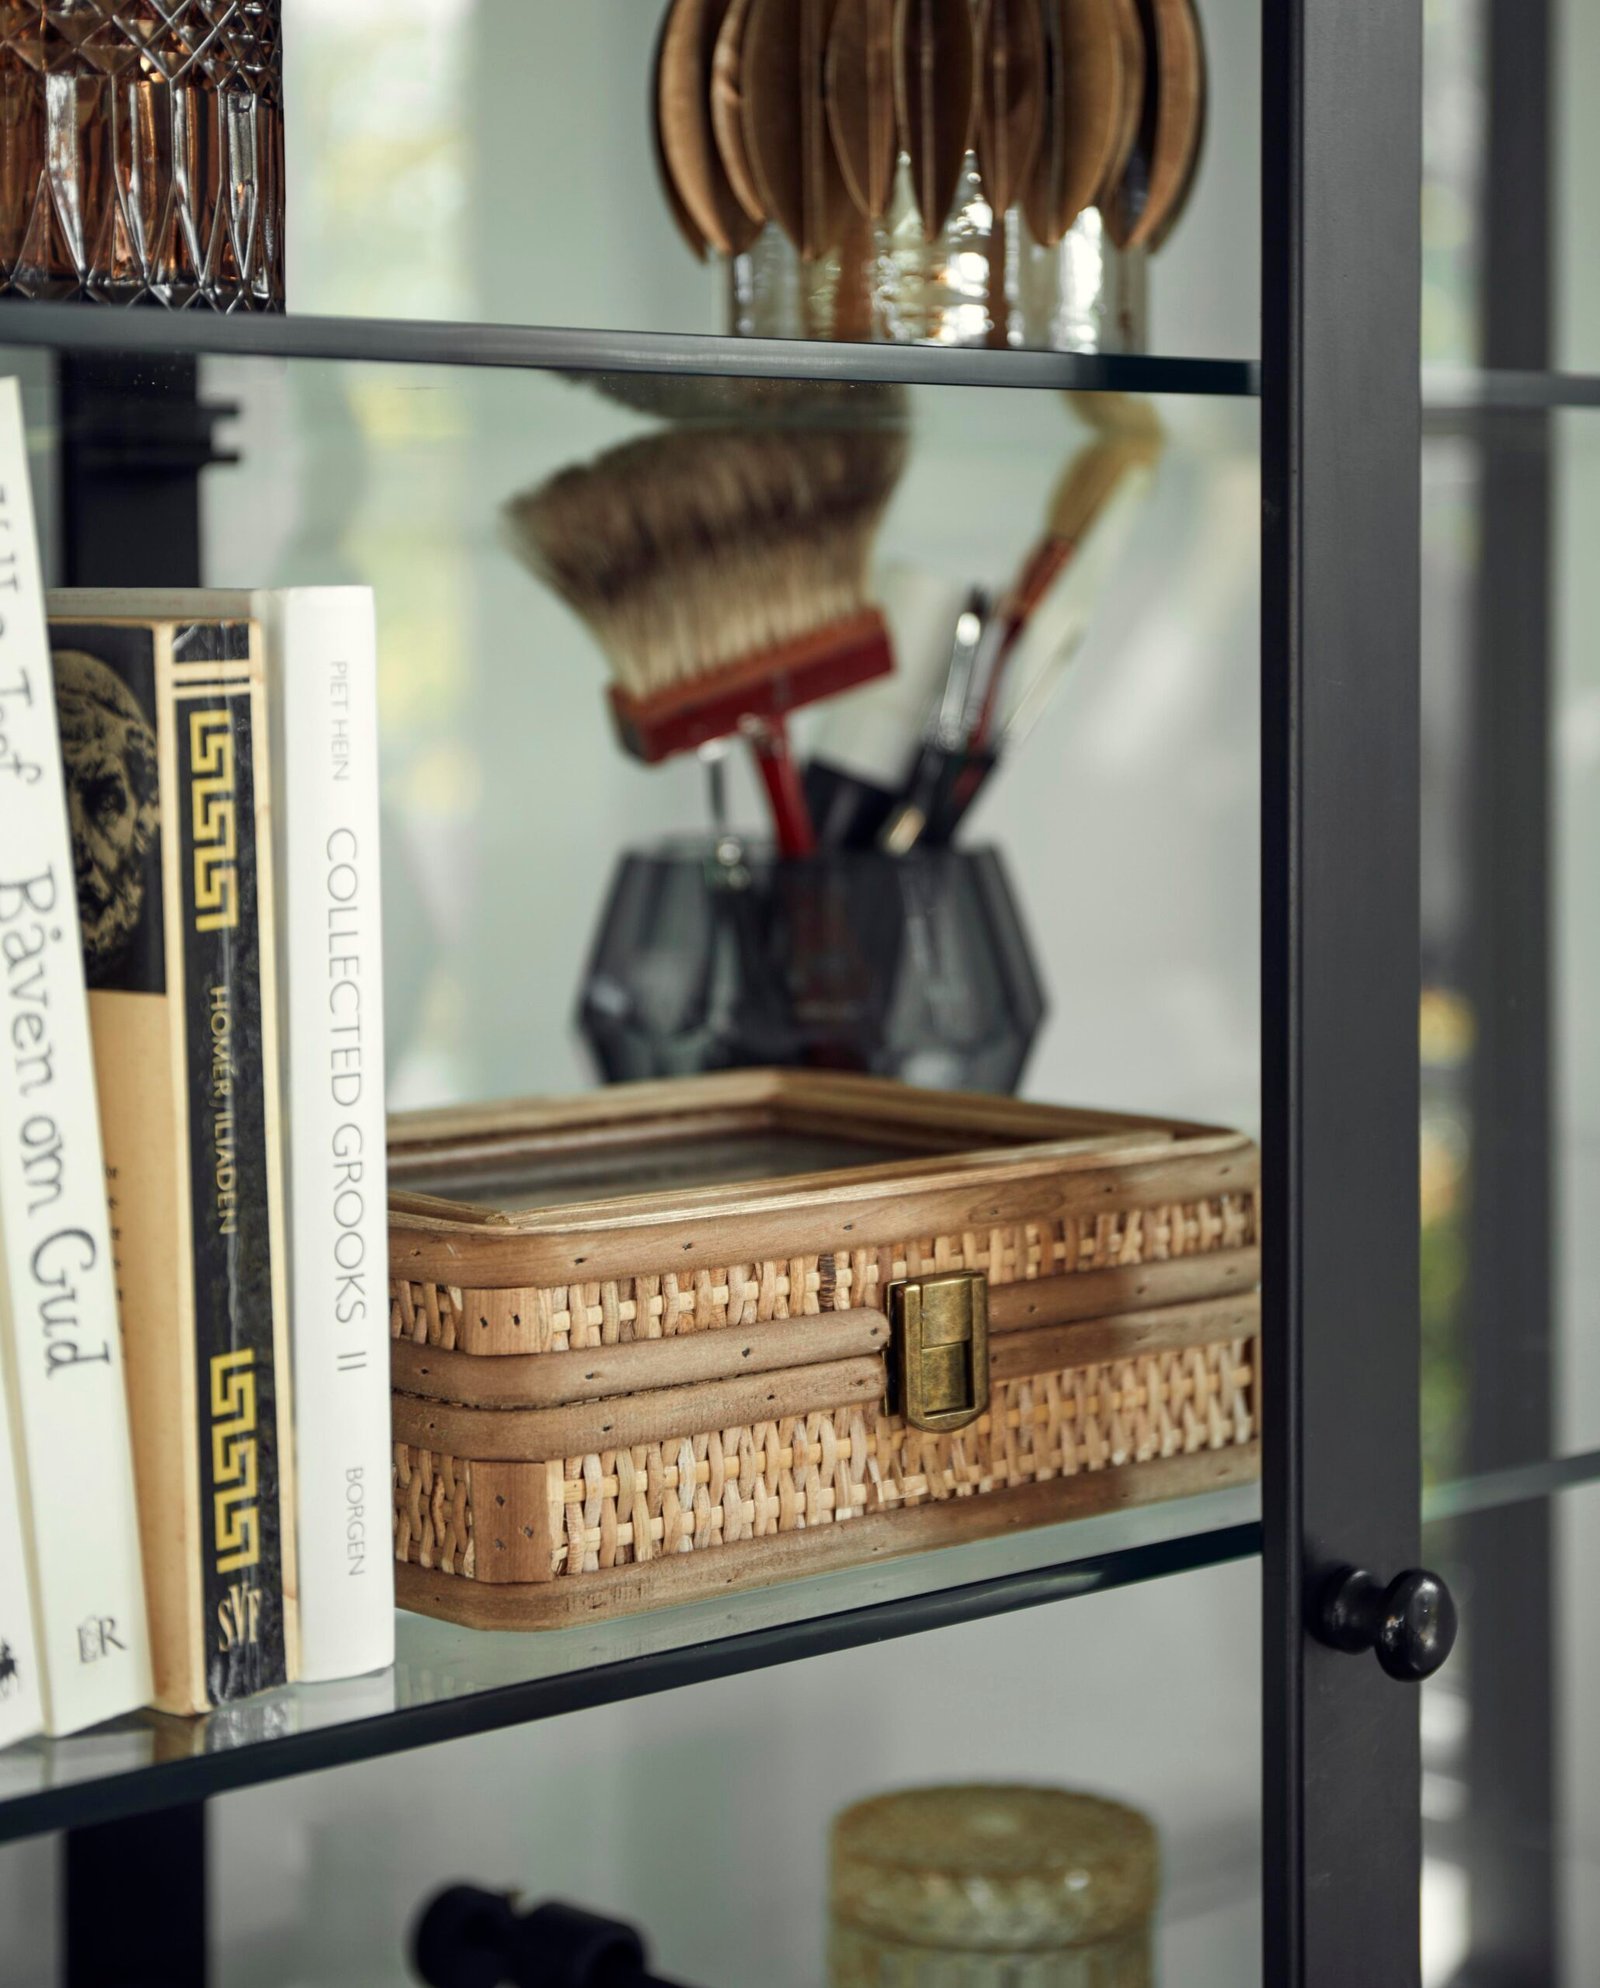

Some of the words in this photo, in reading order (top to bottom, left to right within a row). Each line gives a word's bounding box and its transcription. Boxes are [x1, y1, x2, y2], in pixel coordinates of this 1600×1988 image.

[329, 660, 349, 713] PIET
[331, 718, 350, 782] HEIN
[326, 826, 363, 1108] COLLECTED
[19, 1113, 68, 1216] om
[330, 1122, 367, 1324] GROOKS
[30, 1228, 112, 1379] Gud
[344, 1466, 365, 1577] BORGEN
